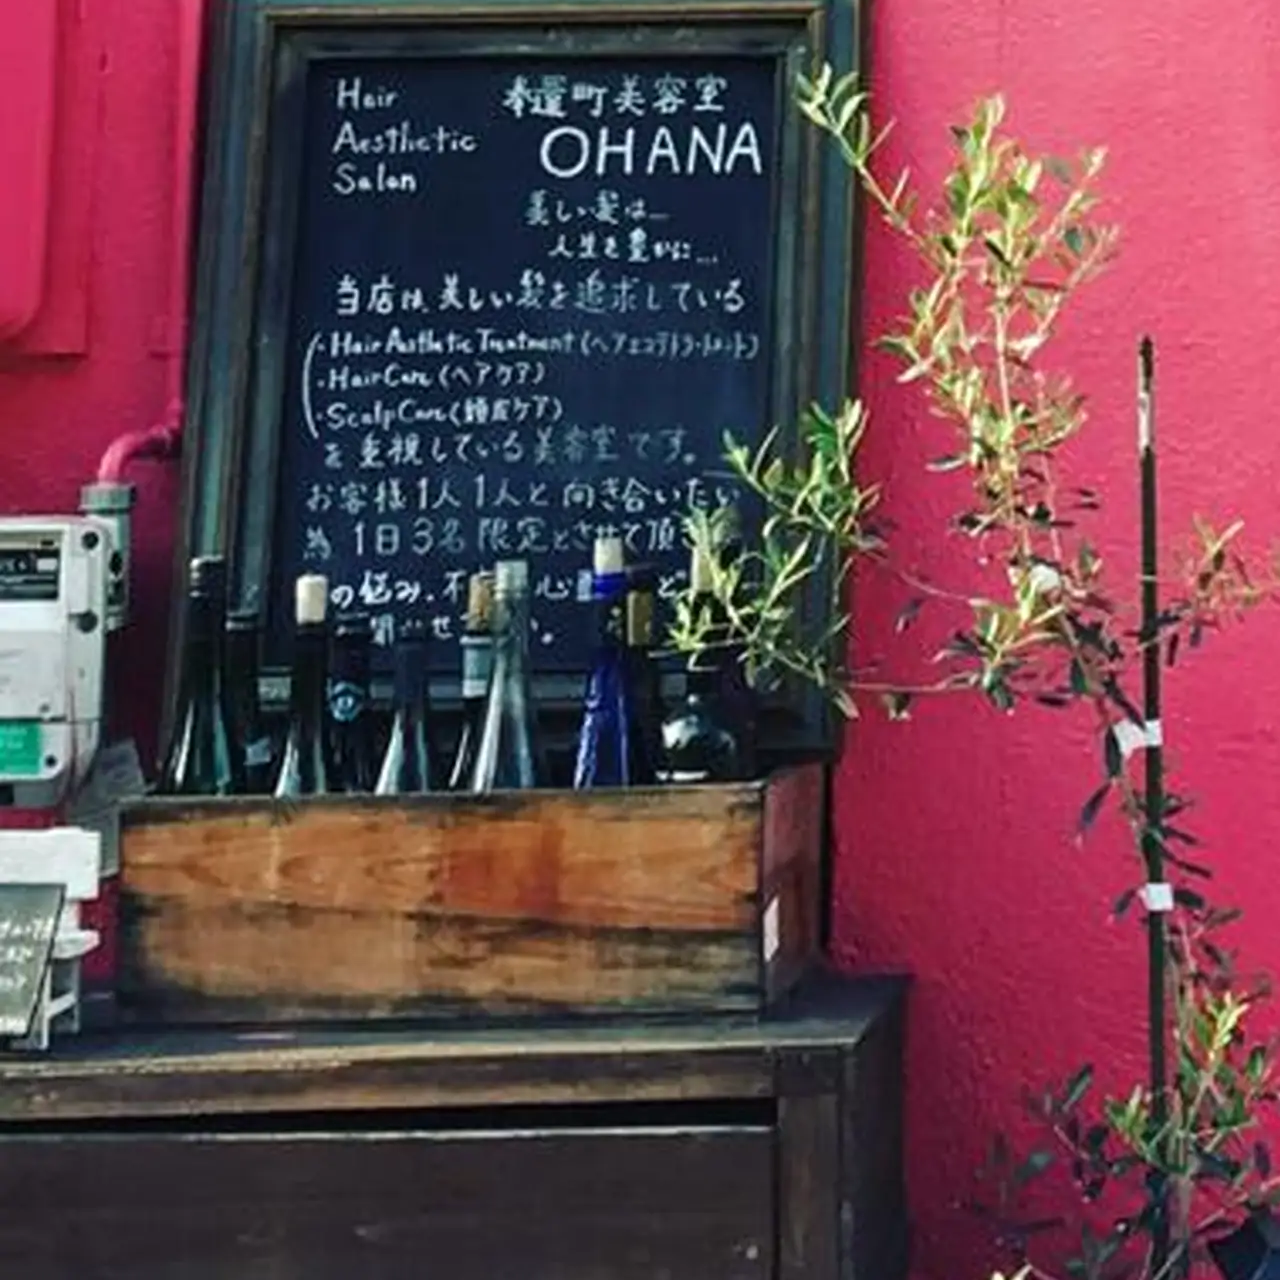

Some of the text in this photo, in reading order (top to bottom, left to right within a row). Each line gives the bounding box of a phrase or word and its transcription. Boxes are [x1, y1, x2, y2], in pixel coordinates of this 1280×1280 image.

[336, 76, 400, 111] Hair
[332, 120, 480, 154] Aesthetic
[539, 121, 763, 178] OHANA
[333, 161, 418, 195] Salon
